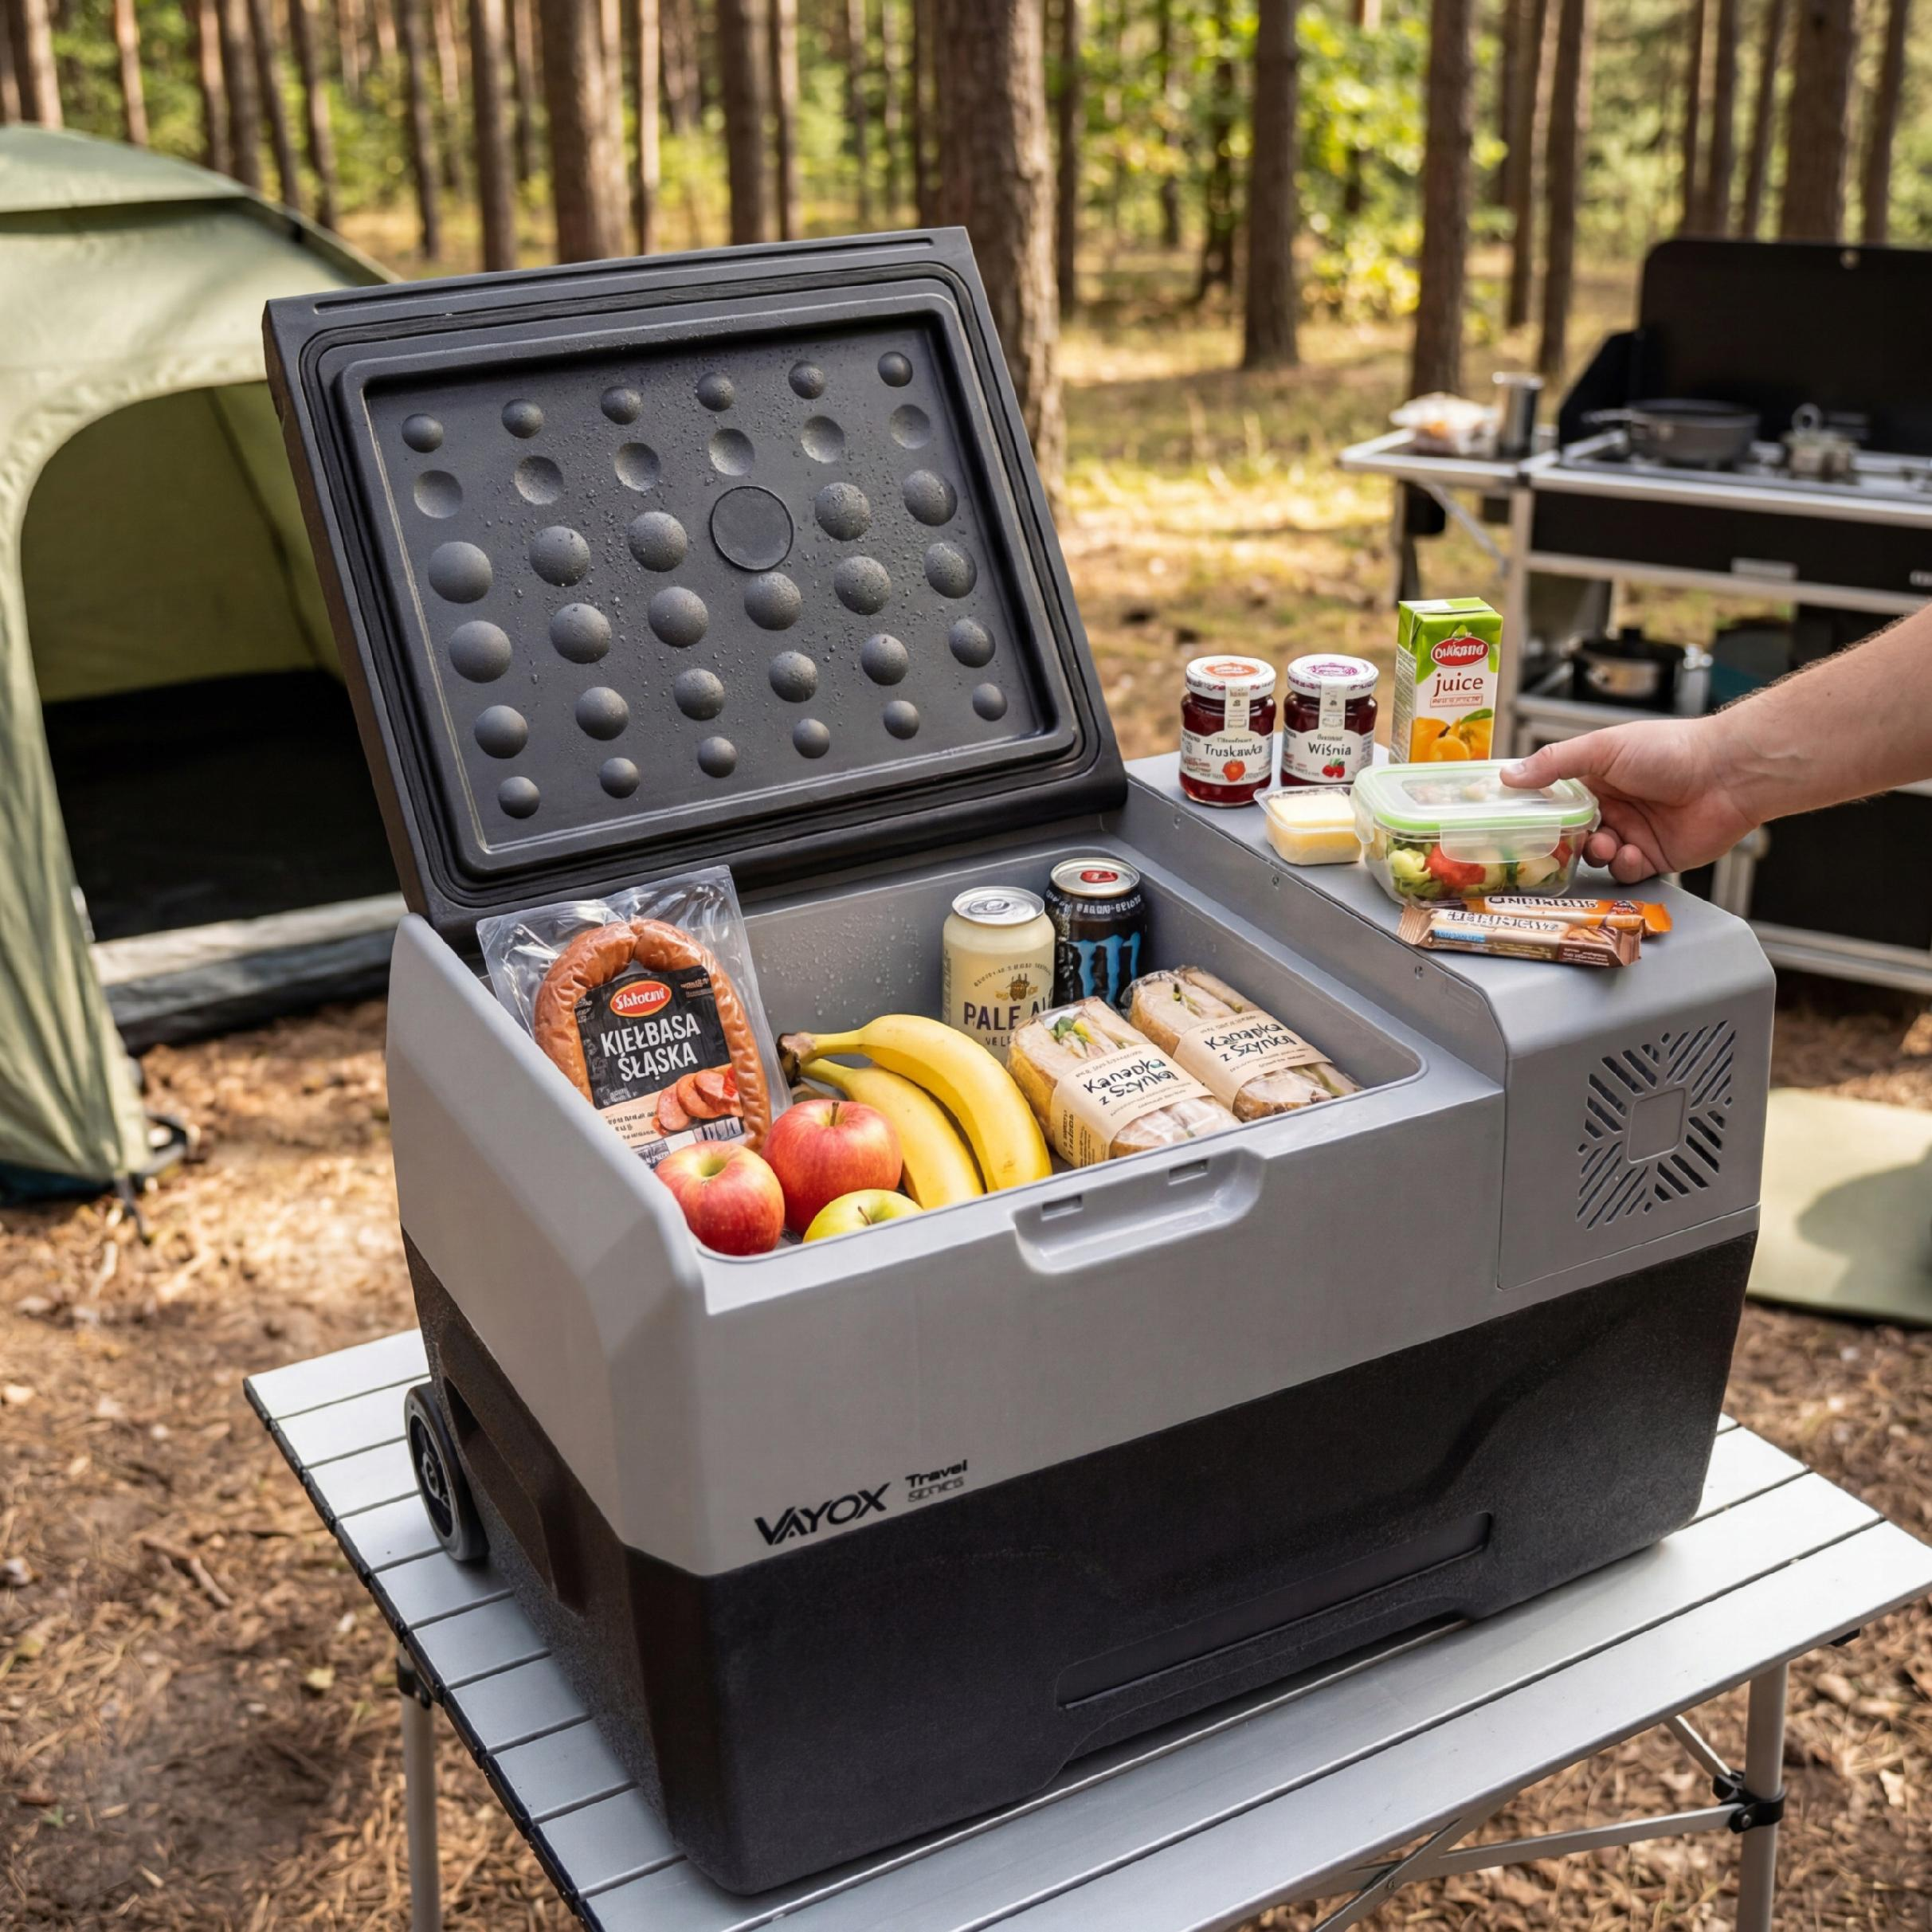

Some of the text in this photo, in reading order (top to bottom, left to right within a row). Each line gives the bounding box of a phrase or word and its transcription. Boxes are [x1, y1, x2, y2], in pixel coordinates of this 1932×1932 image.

[1433, 672, 1483, 697] juice
[1307, 742, 1352, 756] Wiśnia
[963, 1001, 1021, 1031] PALE
[600, 1013, 702, 1058] KIEŁBASA
[617, 1041, 699, 1082] ŚŁĄSKA
[905, 1459, 968, 1488] Travel
[754, 1482, 891, 1546] VAYOX
